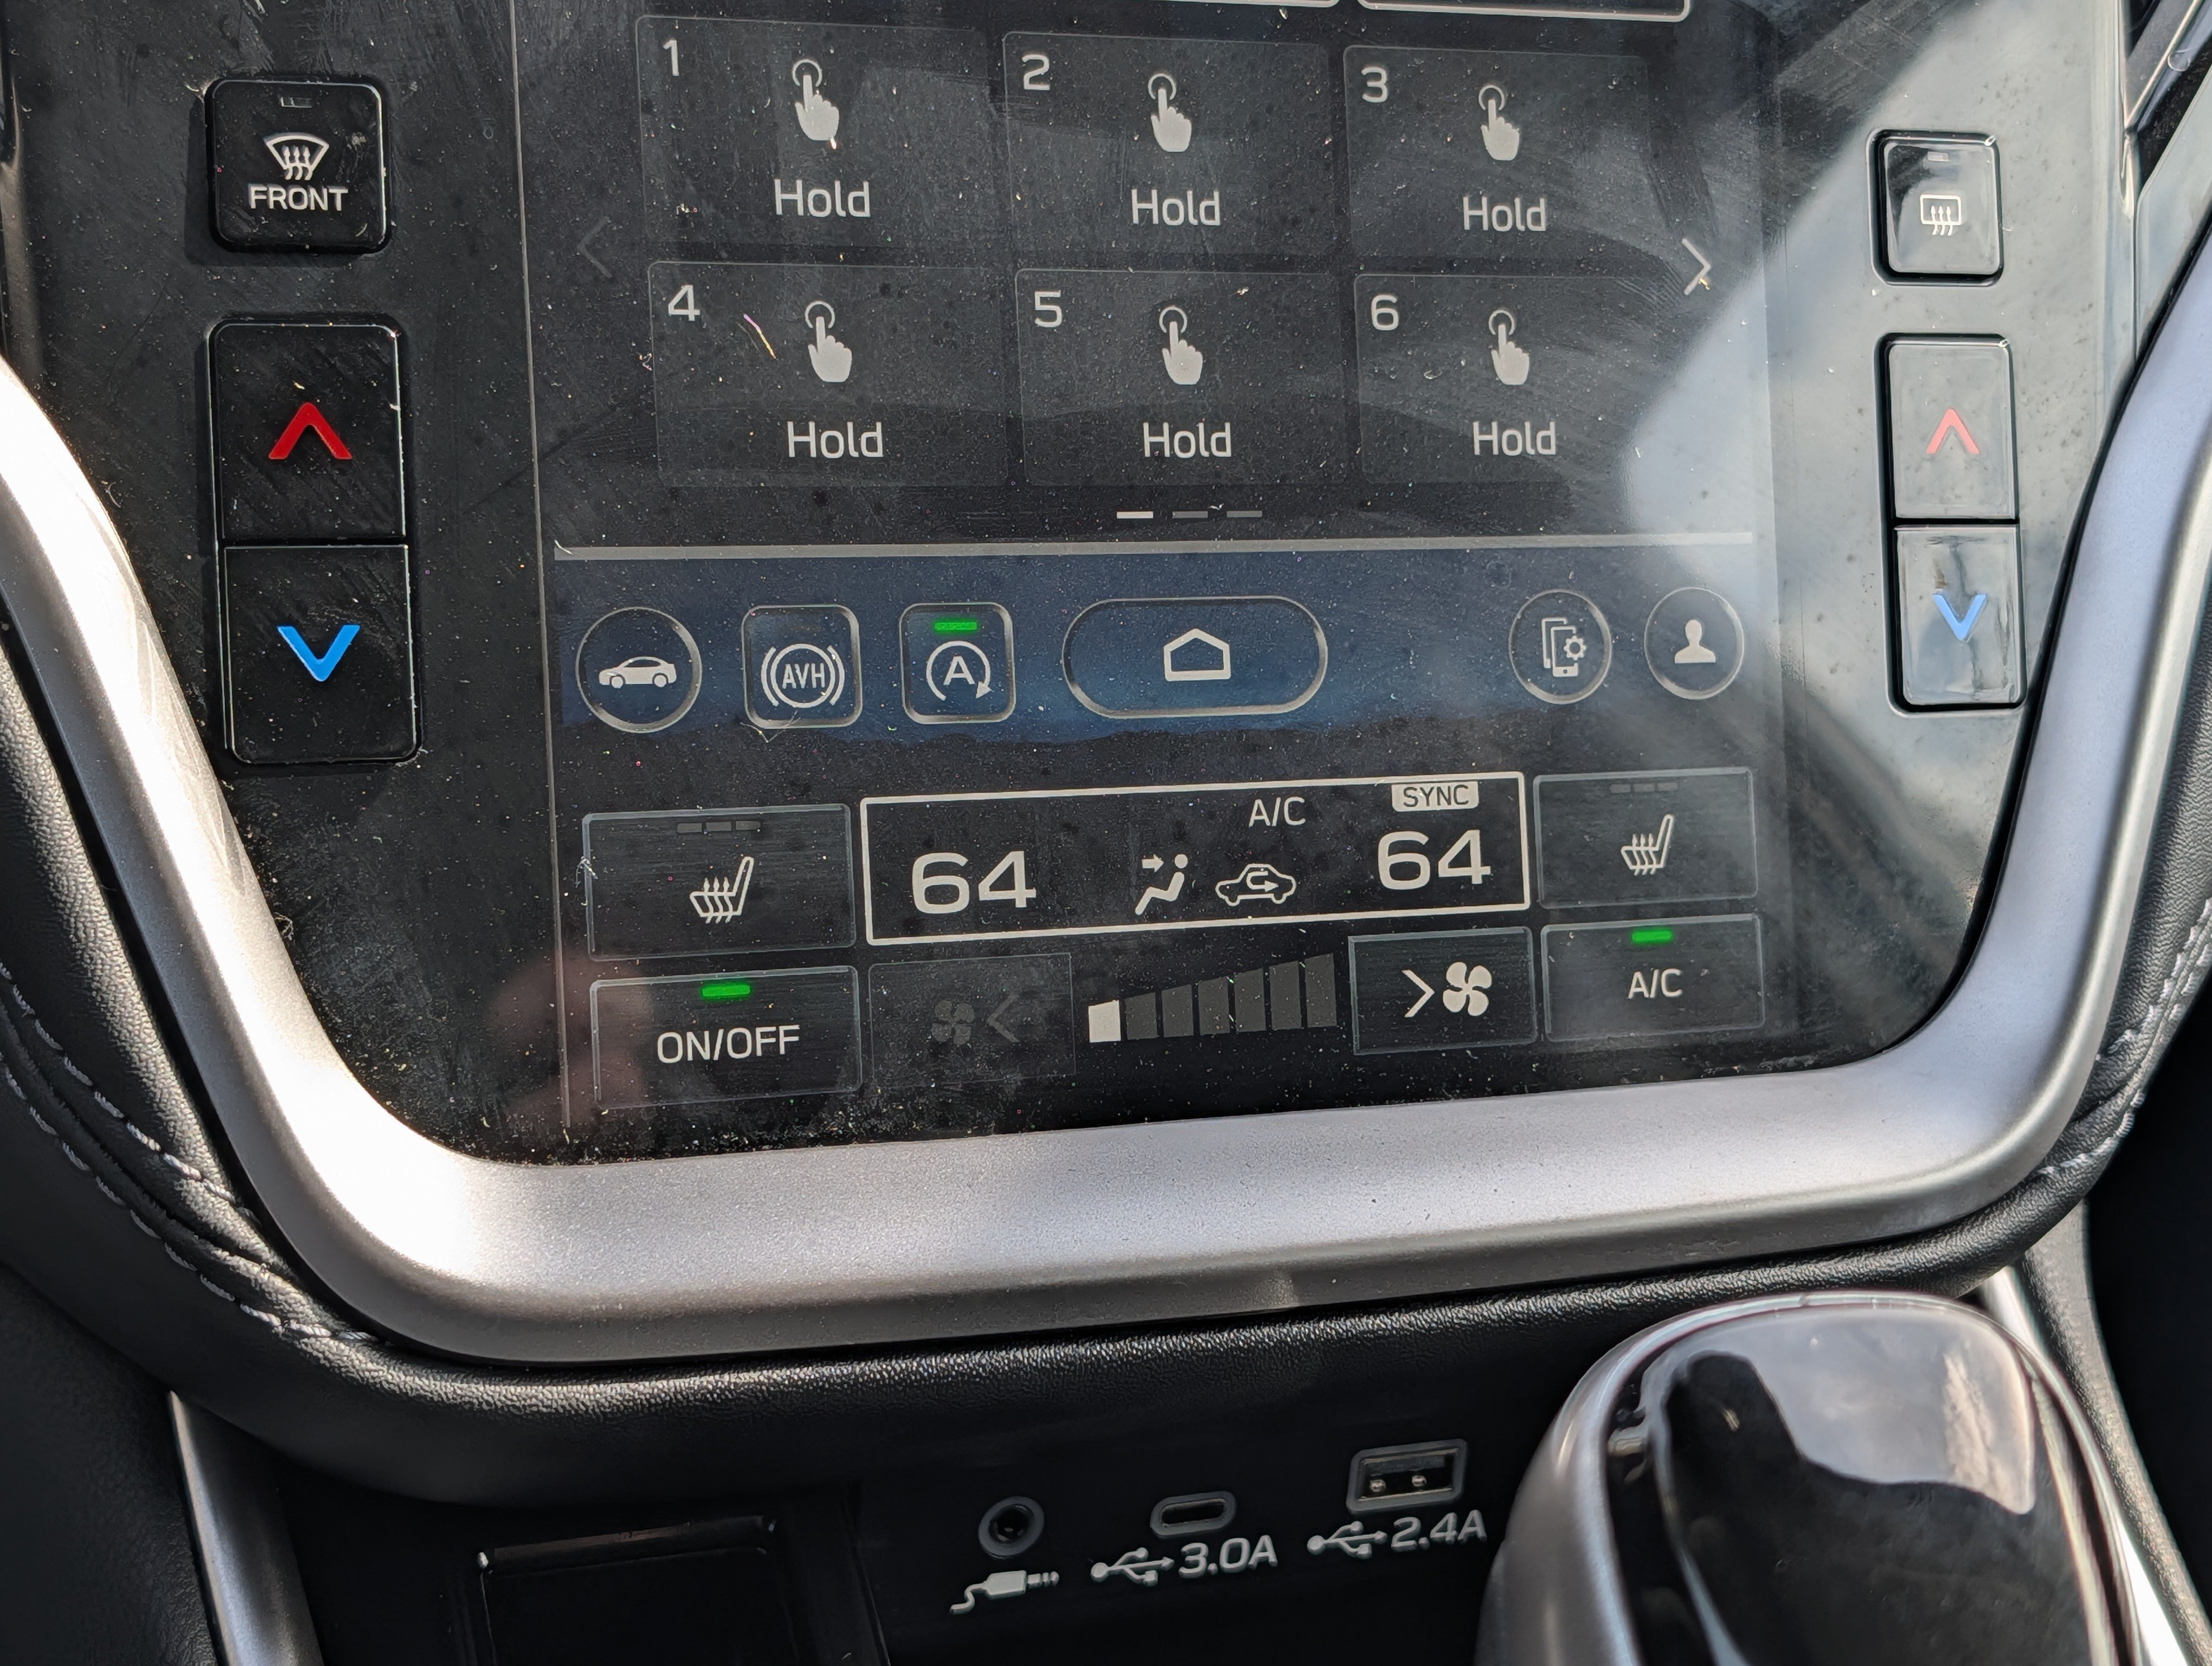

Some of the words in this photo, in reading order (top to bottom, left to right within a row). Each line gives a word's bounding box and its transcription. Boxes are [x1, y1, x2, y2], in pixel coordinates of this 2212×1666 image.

[663, 39, 680, 76] 1
[1021, 54, 1051, 91] 2
[1361, 66, 1389, 104] 3
[248, 183, 349, 212] FRONT
[774, 178, 871, 217] Hold
[1131, 188, 1221, 227] Hold
[1463, 196, 1546, 233] Hold
[667, 284, 700, 322] 4
[1033, 289, 1063, 328] 5
[1370, 293, 1400, 331] 6
[787, 420, 884, 459] Hold
[1142, 421, 1232, 458] Hold
[1472, 420, 1556, 456] Hold
[782, 663, 826, 689] AVH
[943, 655, 975, 686] A
[1248, 797, 1306, 828] A/C
[1402, 784, 1470, 808] SYNC
[1377, 829, 1493, 891] 64
[911, 850, 1037, 915] 64
[1628, 968, 1683, 999] A/C
[656, 1024, 801, 1064] ON/OFF
[1390, 1509, 1488, 1552] 2.4A
[1178, 1535, 1278, 1579] 3.0A
